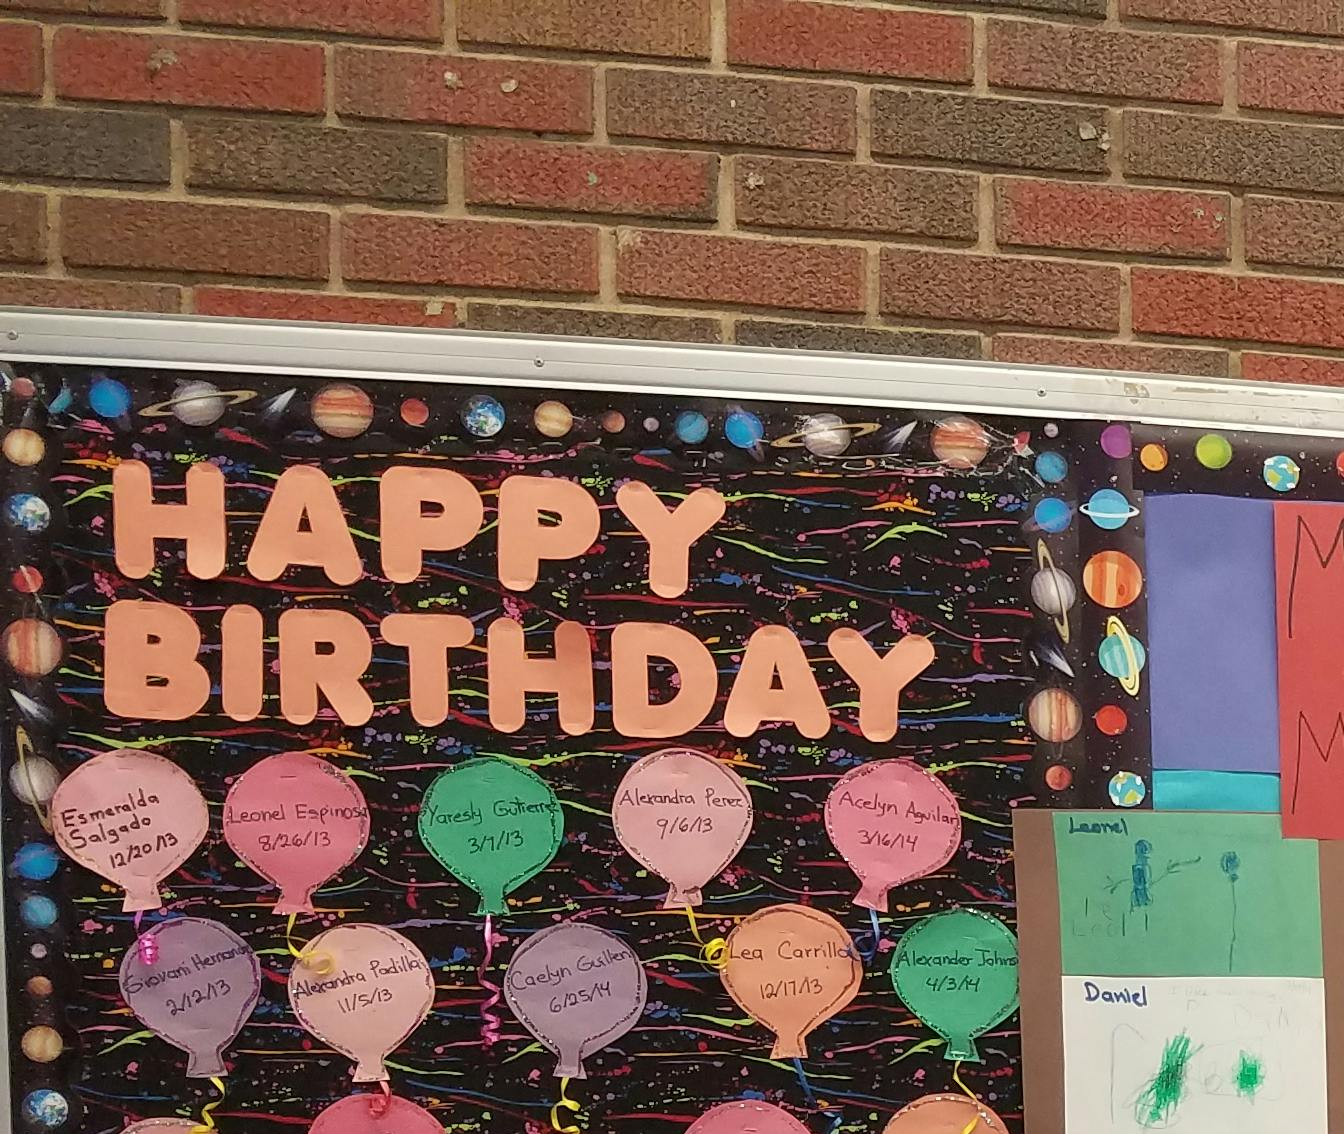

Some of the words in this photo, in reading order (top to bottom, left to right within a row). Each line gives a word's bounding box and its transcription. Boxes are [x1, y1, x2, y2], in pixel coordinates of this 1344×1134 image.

[111, 457, 726, 599] HAPPY
[103, 599, 936, 744] BIRTHDAY
[62, 789, 160, 828] Esmeralda
[618, 787, 696, 807] Alexandra
[705, 788, 745, 809] Perez
[228, 805, 288, 824] Leonel
[424, 804, 485, 827] Yaresly
[657, 816, 714, 835] 9/6/13
[838, 790, 899, 818] Acelyn
[905, 806, 960, 835] Aguilar
[68, 814, 152, 849] Salgado
[258, 830, 331, 853] 8/26/13
[857, 829, 918, 852] 3/16/14
[107, 832, 179, 870] 12/20/13
[729, 939, 764, 961] Lea
[777, 938, 853, 961] Carrillo
[898, 949, 973, 969] Alexander
[292, 970, 367, 1000] Alexandra
[370, 957, 423, 982] Padilla
[510, 967, 573, 995] Caelyn
[576, 947, 633, 975] Guillen
[924, 975, 981, 994] 4/3/14
[165, 979, 232, 1018] 2/12/13
[336, 987, 394, 1016] 11/5/13
[549, 981, 612, 1015] 6/25/14
[759, 975, 825, 1000] 12/17/13
[1083, 981, 1149, 1009] Daniel
